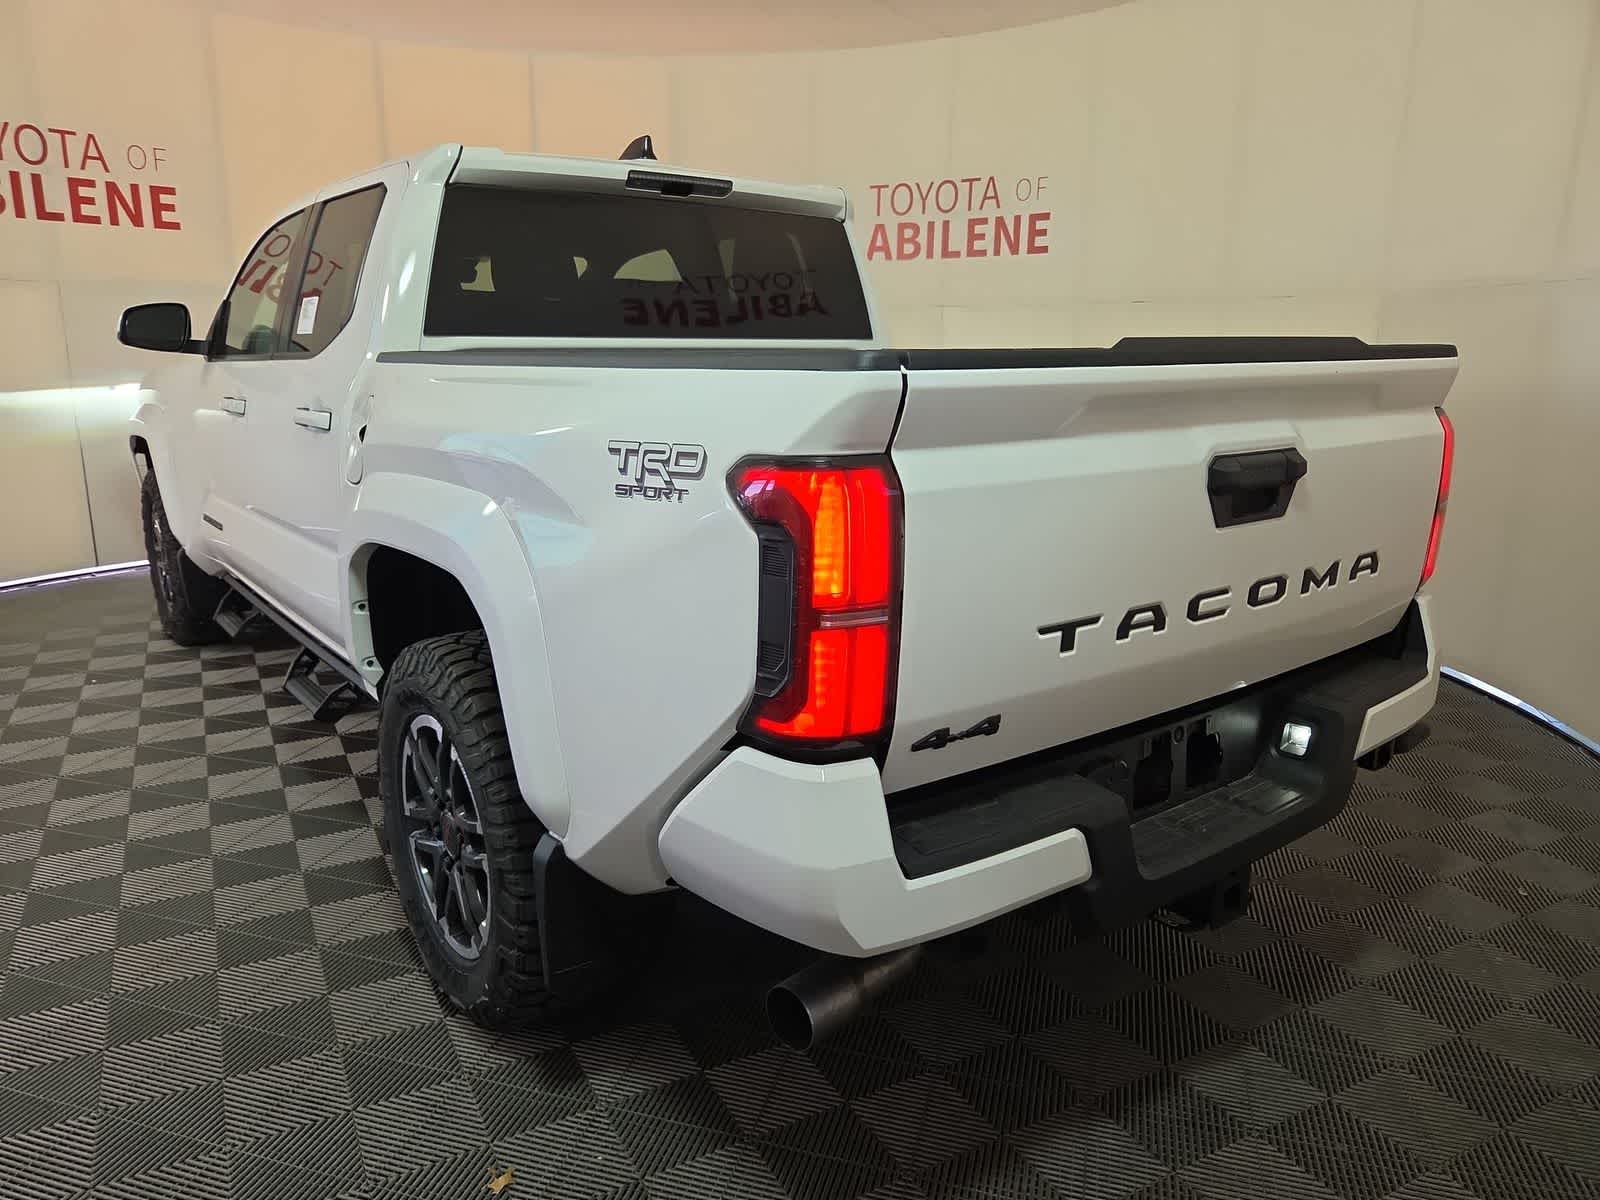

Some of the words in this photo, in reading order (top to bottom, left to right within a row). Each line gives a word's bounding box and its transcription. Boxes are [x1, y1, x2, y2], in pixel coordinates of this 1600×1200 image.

[126, 144, 168, 172] OF
[869, 176, 1001, 217] TOYOTA
[1015, 176, 1049, 202] OF
[866, 212, 1051, 262] ABILENE
[608, 440, 708, 488] TRD
[615, 484, 690, 503] SPORT
[1037, 551, 1380, 656] TACOMA
